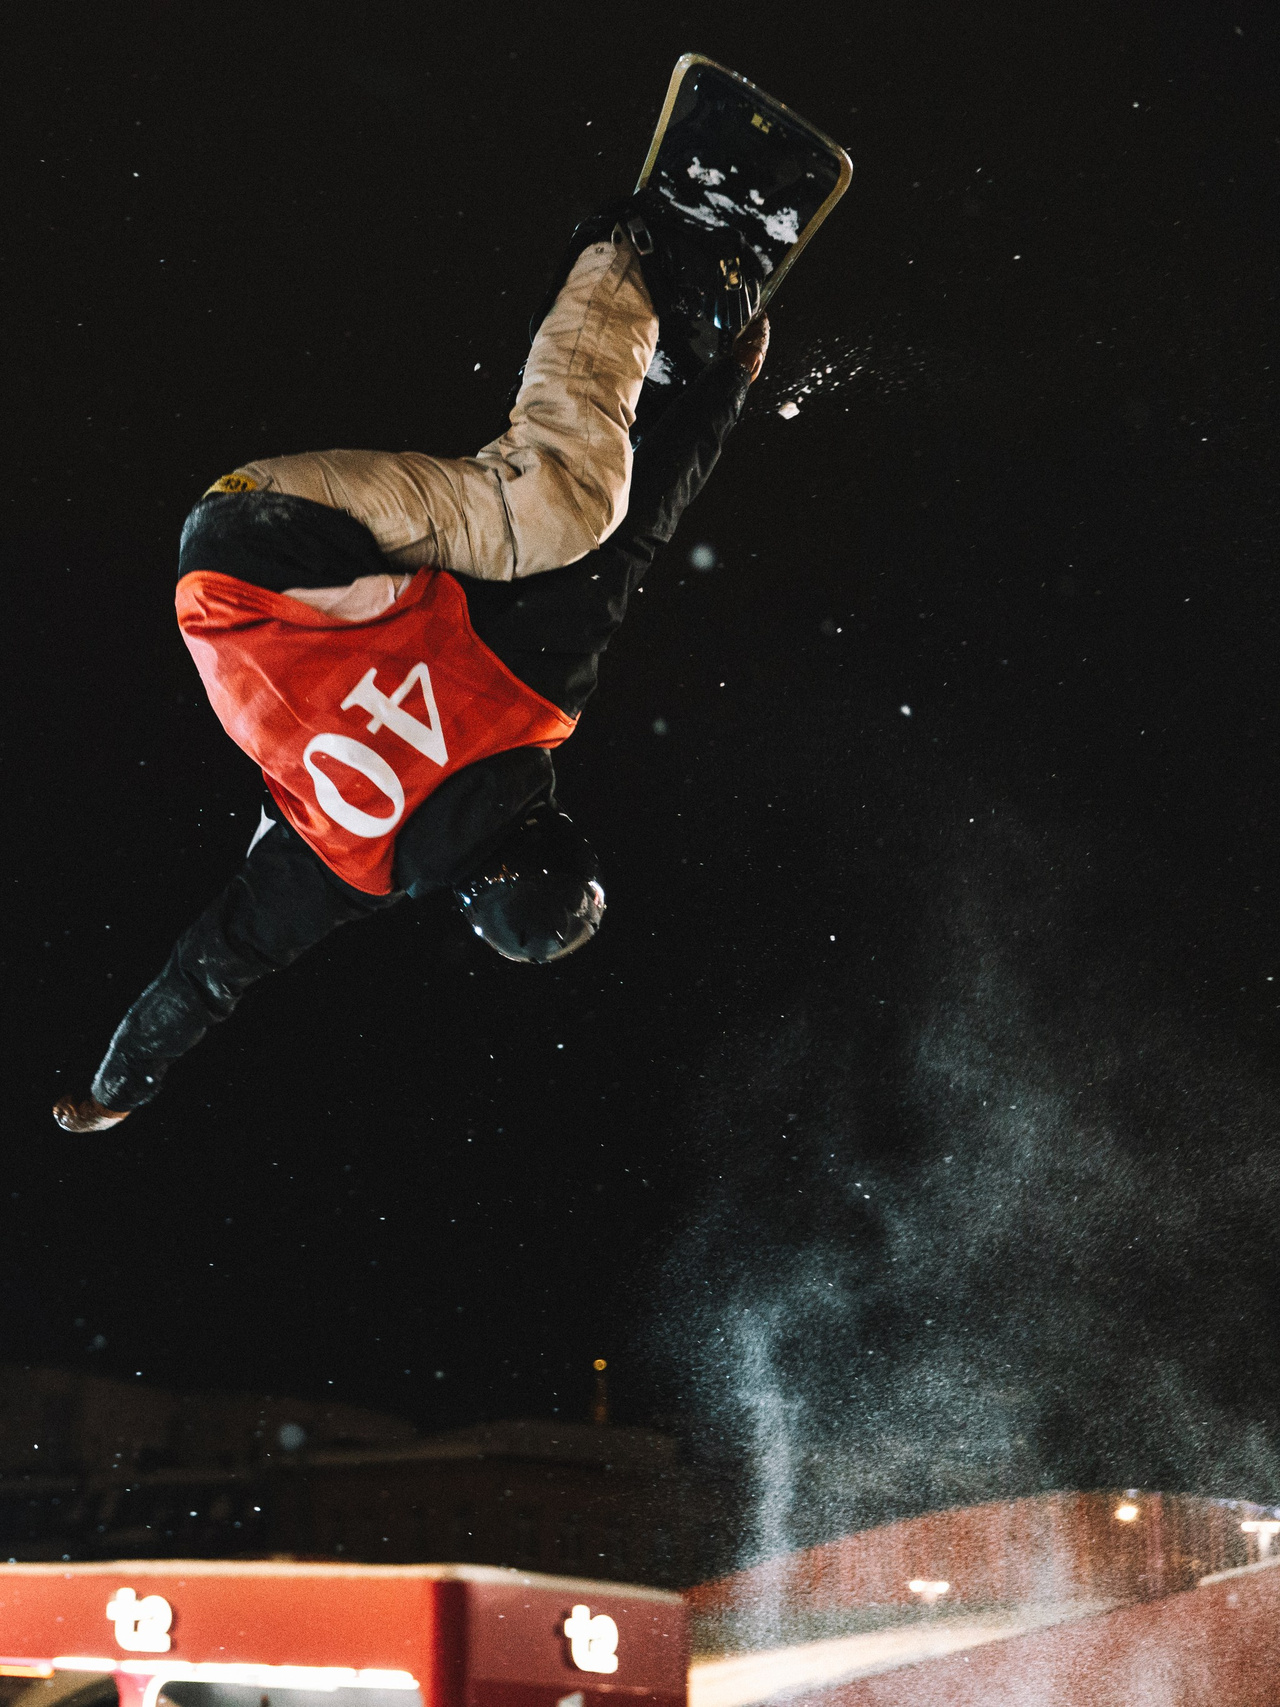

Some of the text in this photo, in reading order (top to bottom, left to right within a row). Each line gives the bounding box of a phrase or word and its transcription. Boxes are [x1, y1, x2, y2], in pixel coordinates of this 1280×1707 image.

[303, 661, 449, 838] 40
[106, 1587, 173, 1653] t2
[564, 1604, 619, 1674] t2
